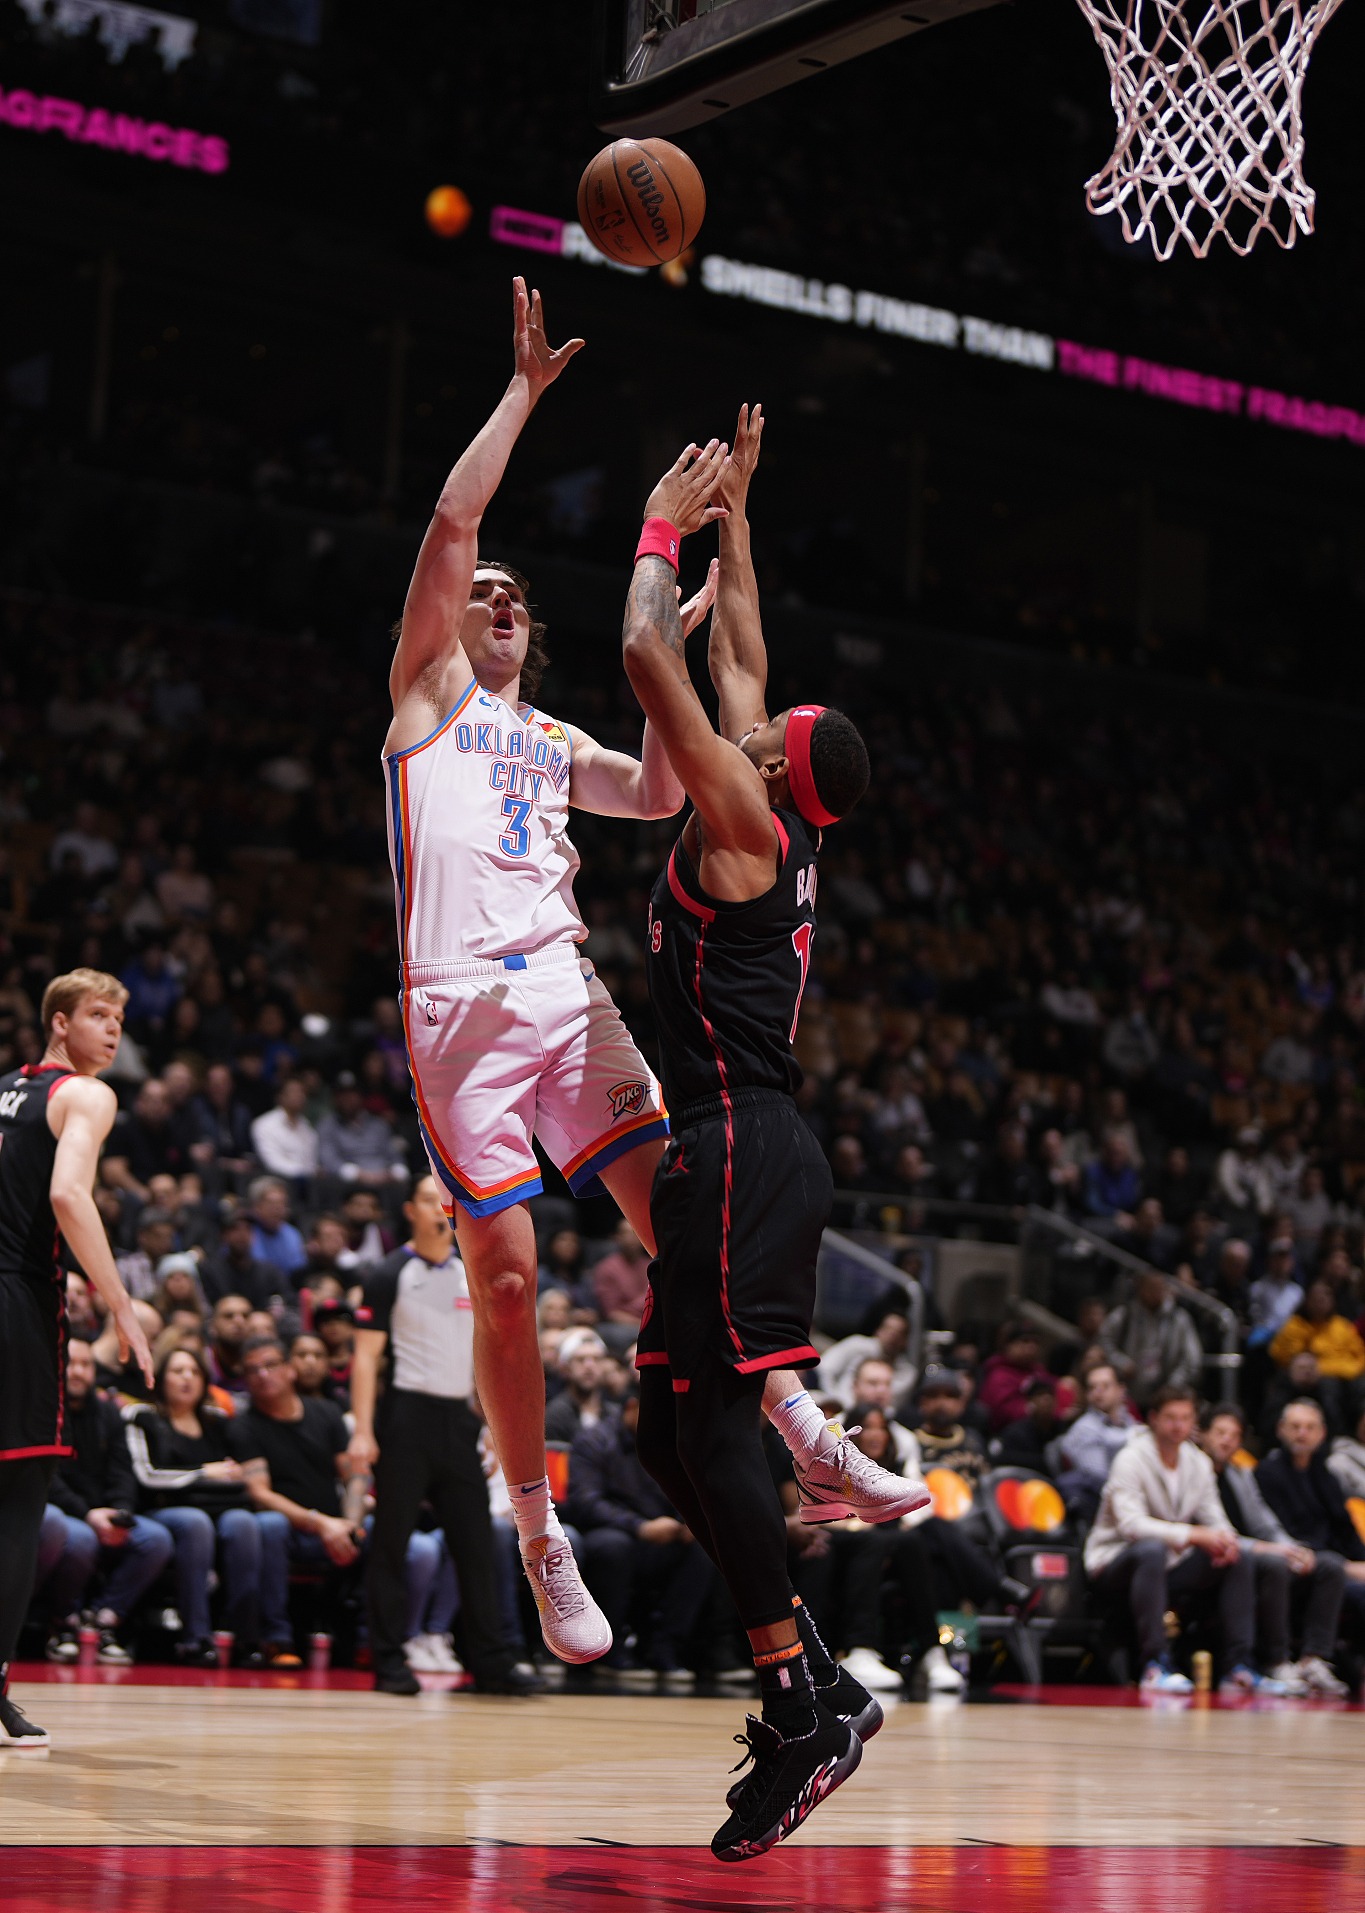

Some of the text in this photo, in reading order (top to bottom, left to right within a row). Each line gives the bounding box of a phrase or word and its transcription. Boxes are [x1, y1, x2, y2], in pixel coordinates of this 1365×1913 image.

[627, 159, 669, 246] Wilson
[701, 254, 852, 322] SMELLS
[854, 289, 960, 349] FINER
[962, 314, 1056, 371] THAN
[1055, 338, 1119, 388] THE
[1121, 354, 1245, 417] FINEST
[455, 722, 570, 794] OKLAHOMA
[489, 760, 546, 802] CITY
[499, 794, 534, 859] 3
[613, 1085, 640, 1116] OKC
